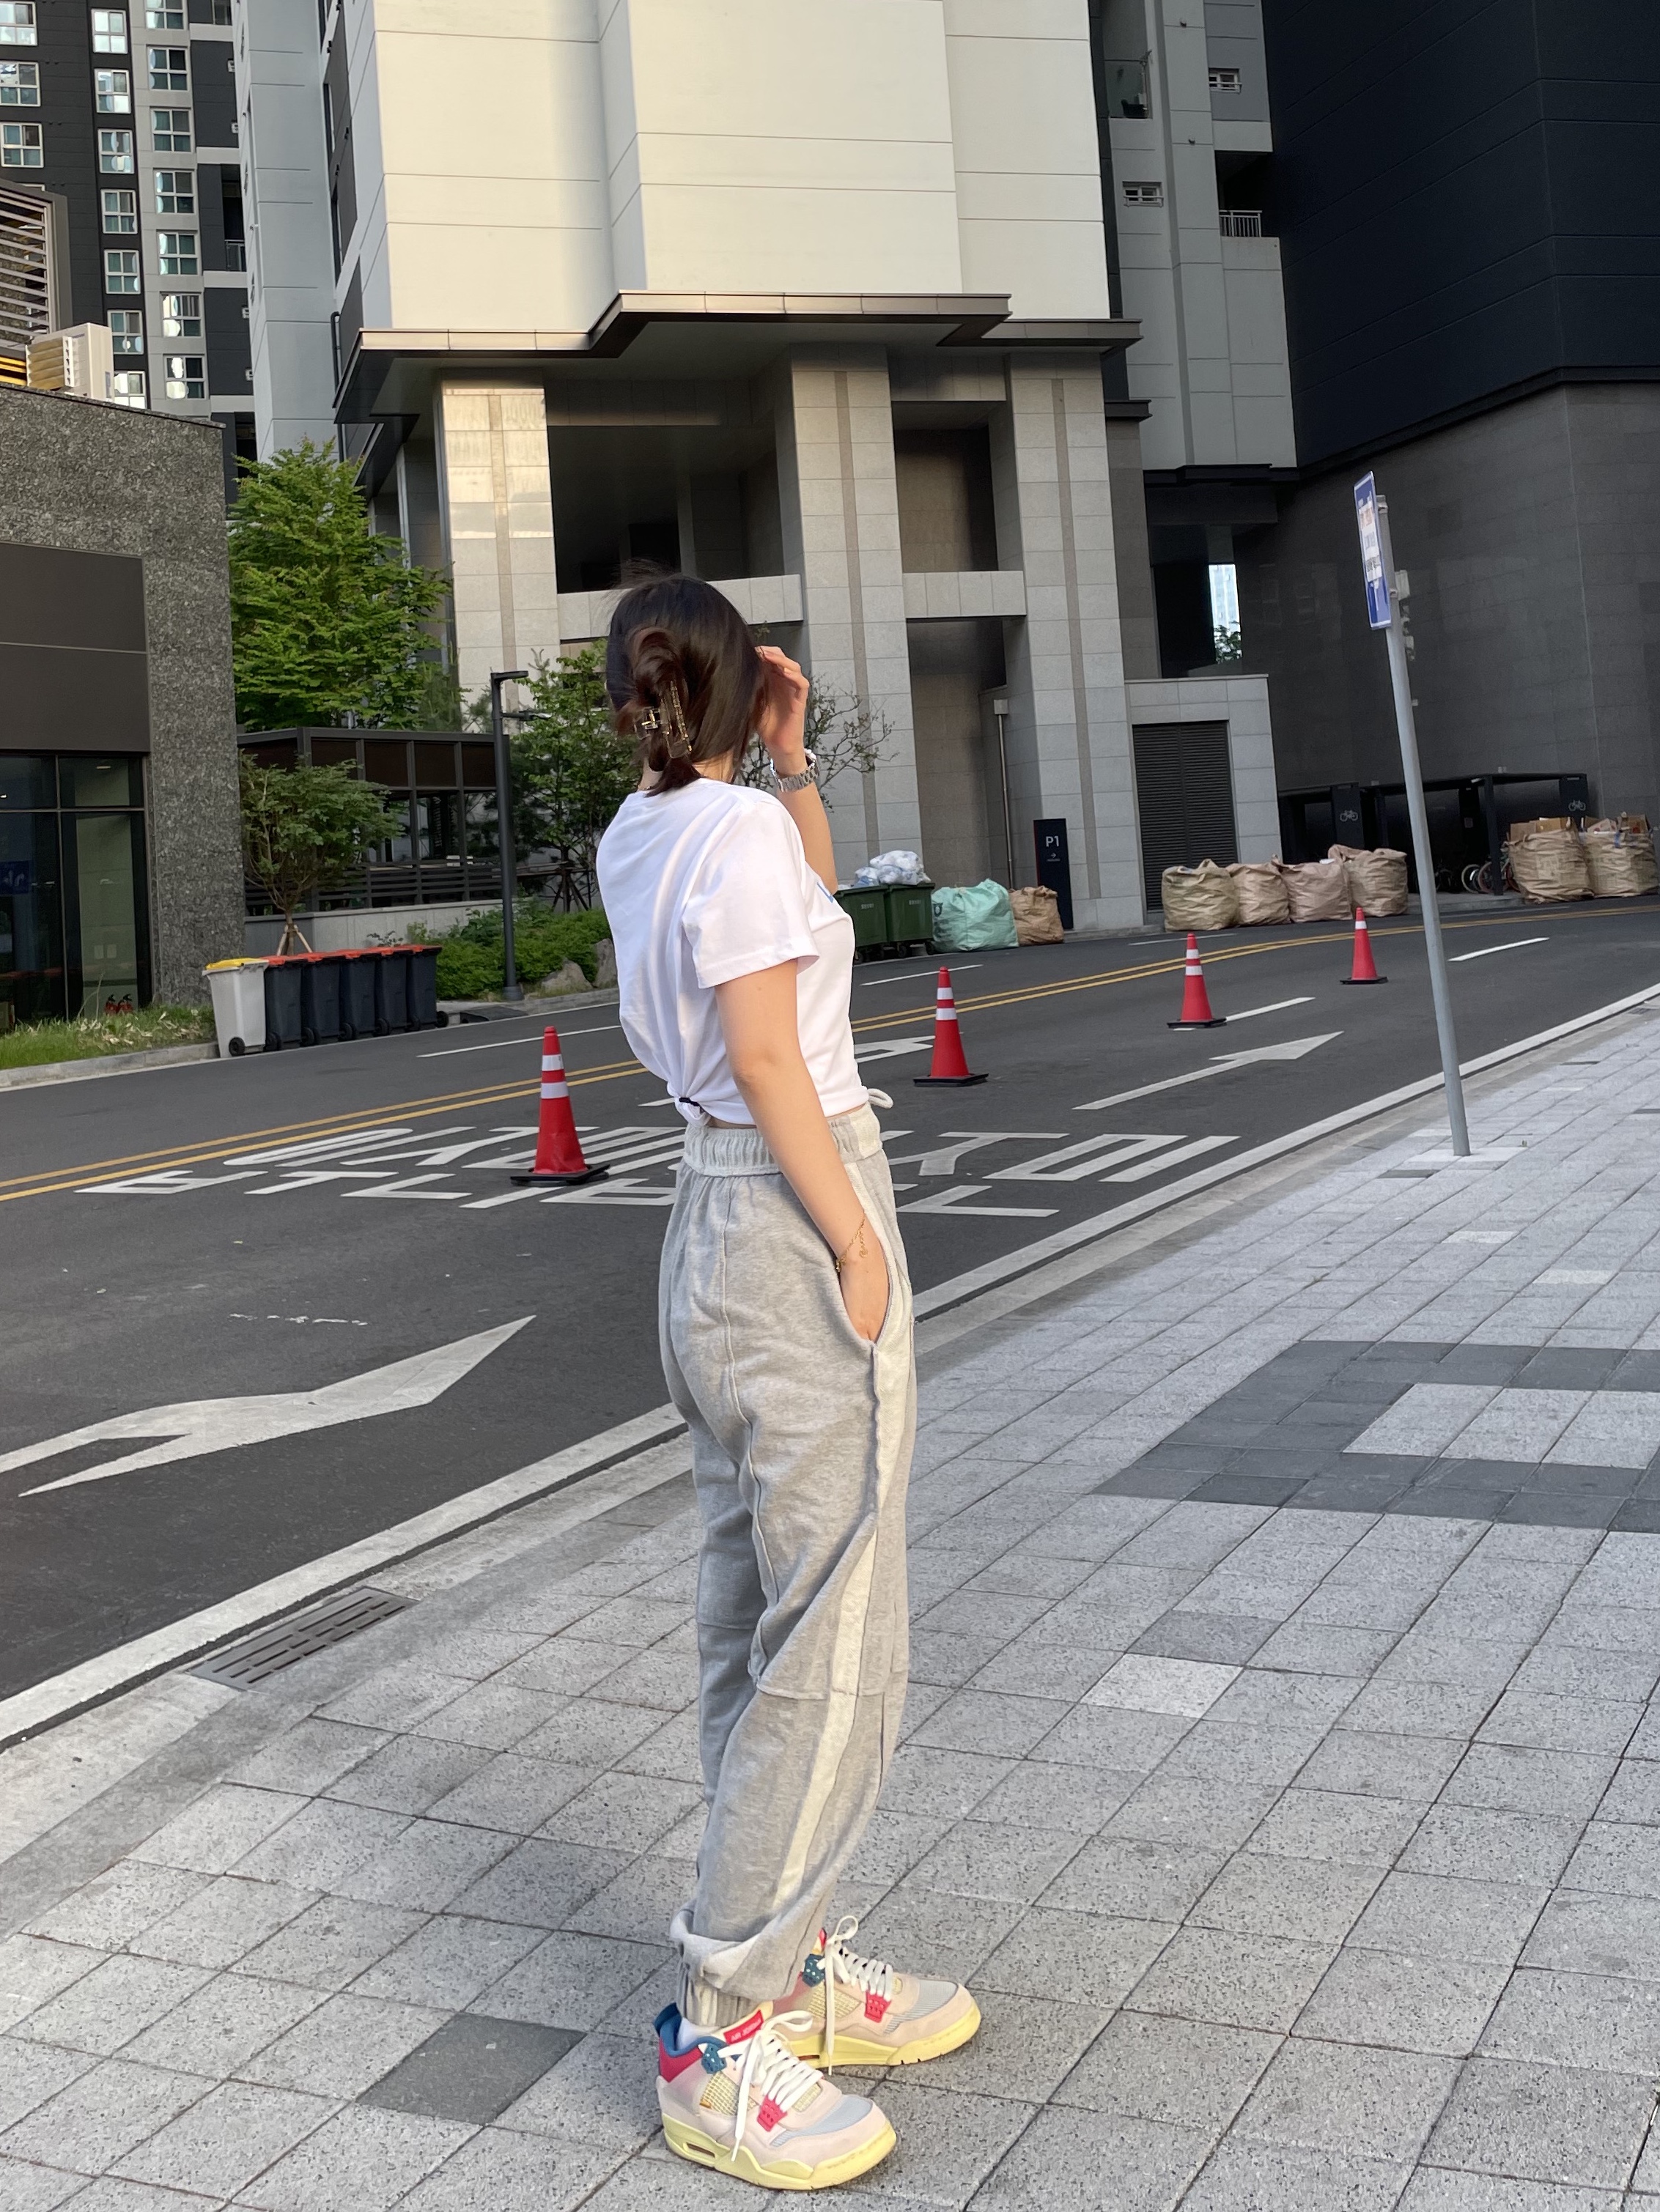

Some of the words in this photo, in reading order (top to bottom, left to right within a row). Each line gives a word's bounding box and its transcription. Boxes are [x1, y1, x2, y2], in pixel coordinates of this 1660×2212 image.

[1045, 835, 1060, 848] P1
[75, 1126, 685, 1200] 입주민
[731, 2032, 742, 2041] AIR
